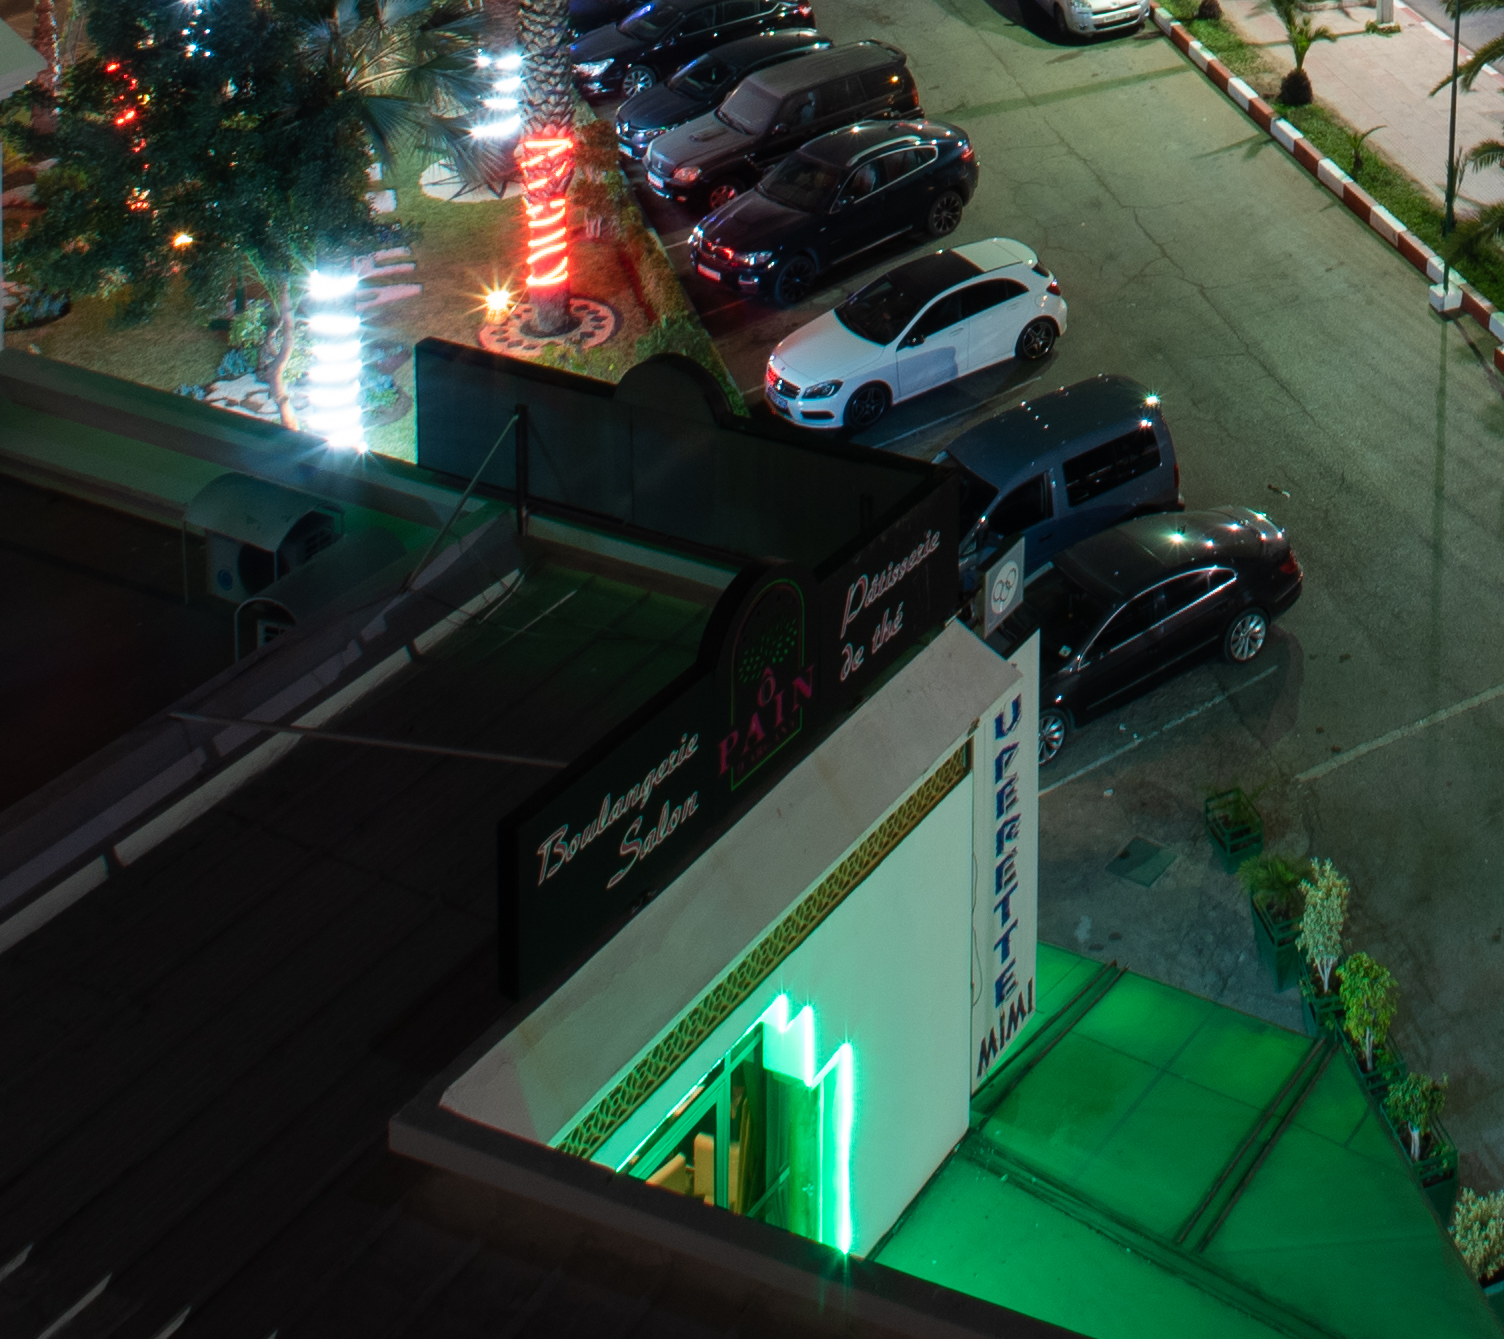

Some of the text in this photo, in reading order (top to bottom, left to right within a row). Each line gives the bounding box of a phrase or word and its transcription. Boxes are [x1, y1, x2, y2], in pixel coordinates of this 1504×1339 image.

[839, 601, 904, 683] de thé
[717, 663, 815, 778] PAIN
[536, 732, 699, 887] Boulangerie
[605, 790, 699, 891] Salon
[993, 692, 1023, 1009] UPERETTE
[976, 976, 1034, 1079] MIMI
